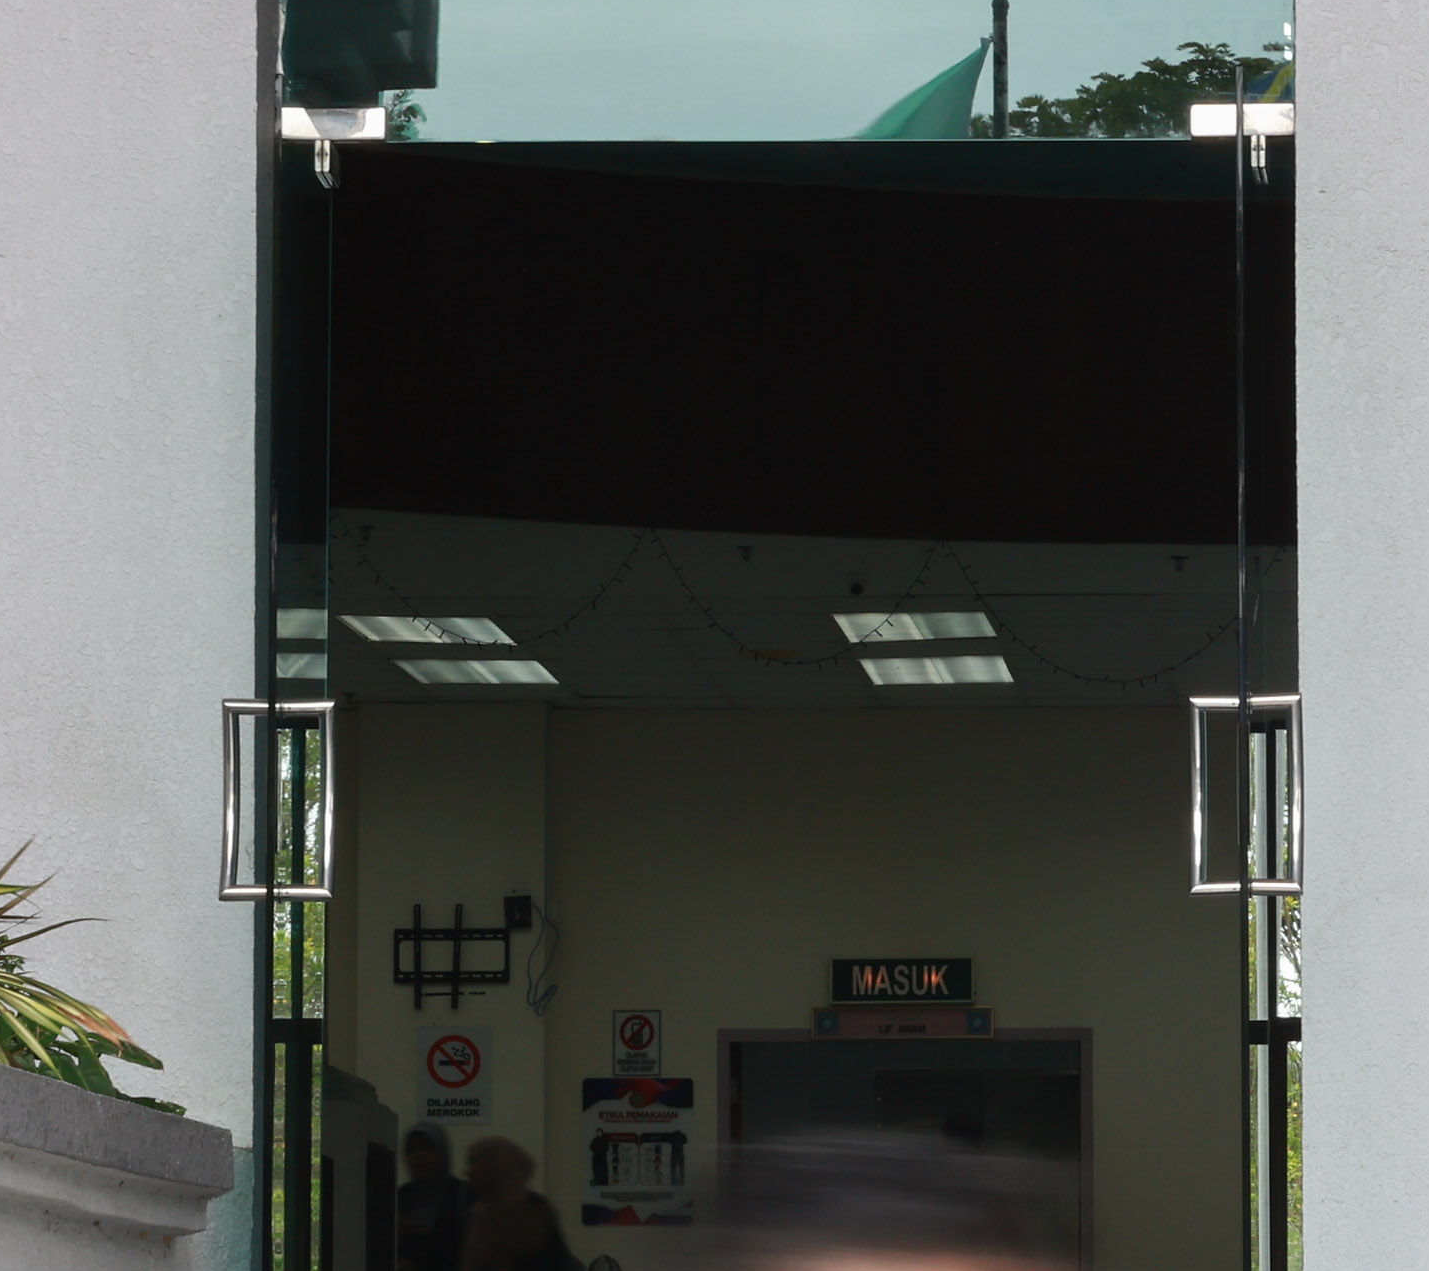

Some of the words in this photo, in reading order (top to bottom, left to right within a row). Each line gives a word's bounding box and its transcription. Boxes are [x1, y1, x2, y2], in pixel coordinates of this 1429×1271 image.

[851, 964, 950, 996] MASUK
[426, 1098, 480, 1107] DILARANG
[426, 1108, 480, 1117] MEROKOK
